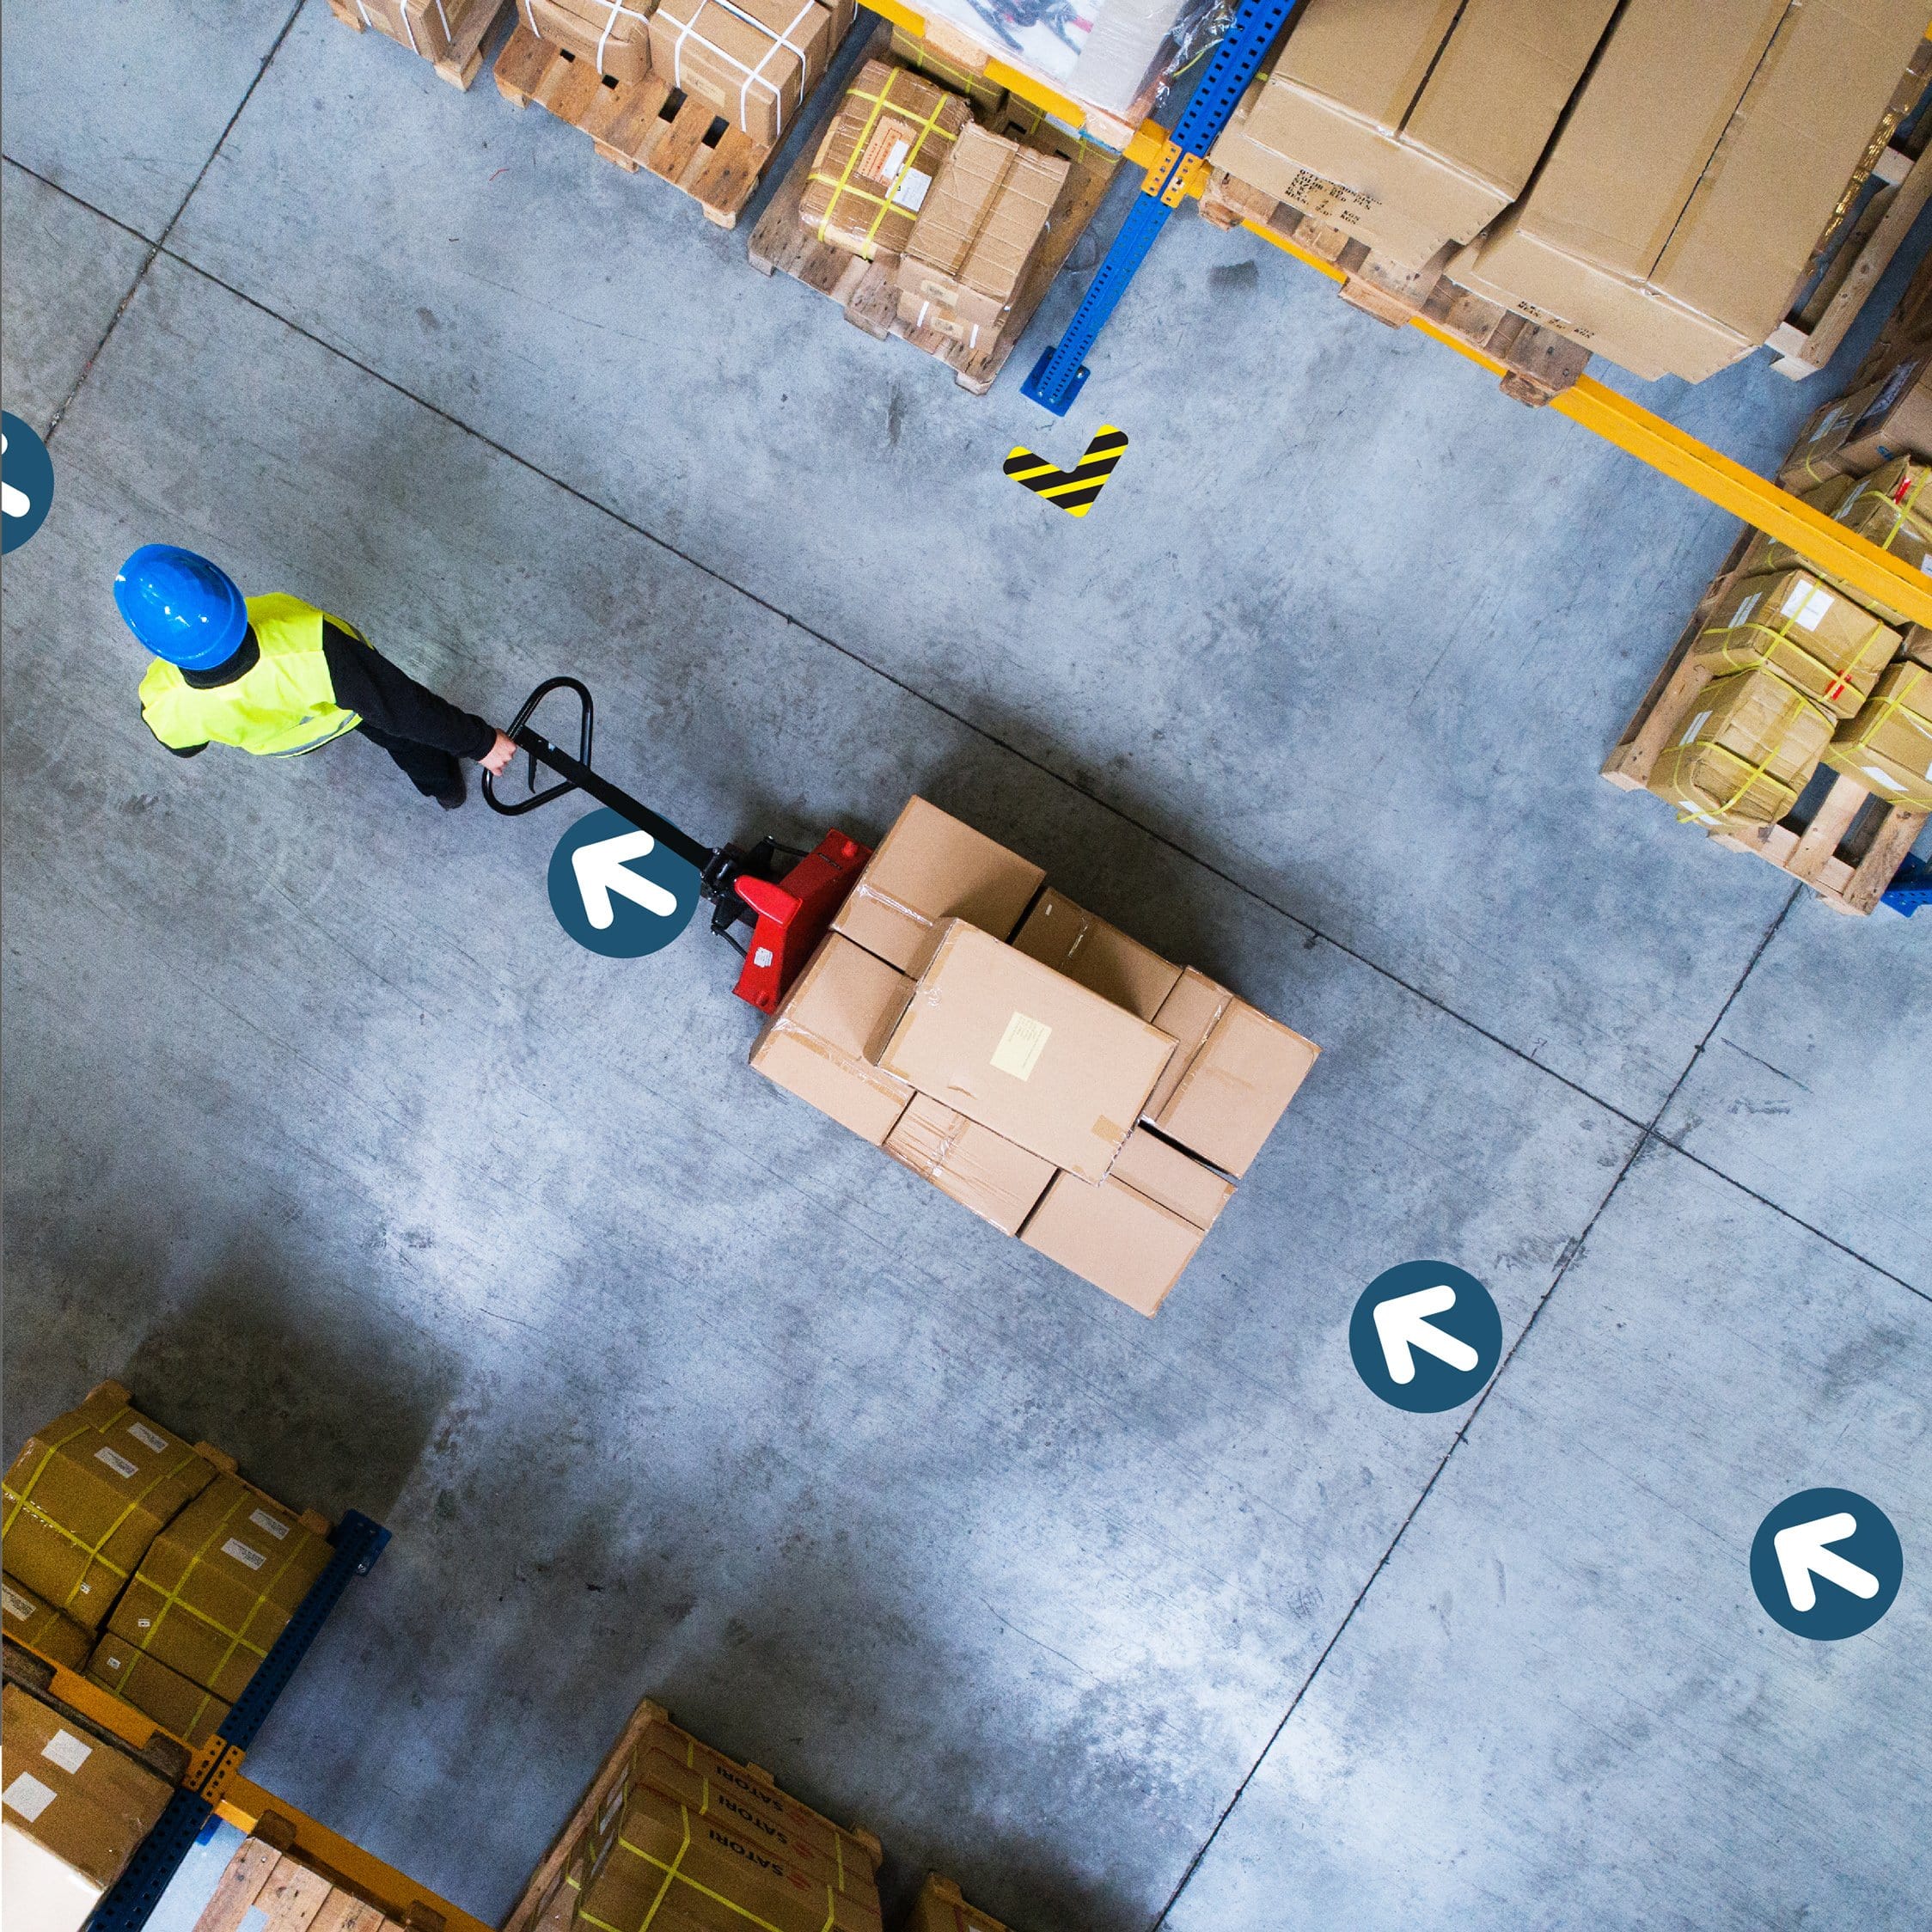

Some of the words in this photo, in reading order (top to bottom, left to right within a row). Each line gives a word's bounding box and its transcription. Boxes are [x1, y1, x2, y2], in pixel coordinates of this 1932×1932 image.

[716, 1765, 783, 1812] SATORI
[718, 1794, 787, 1844] SATORI
[709, 1829, 783, 1877] SATORI
